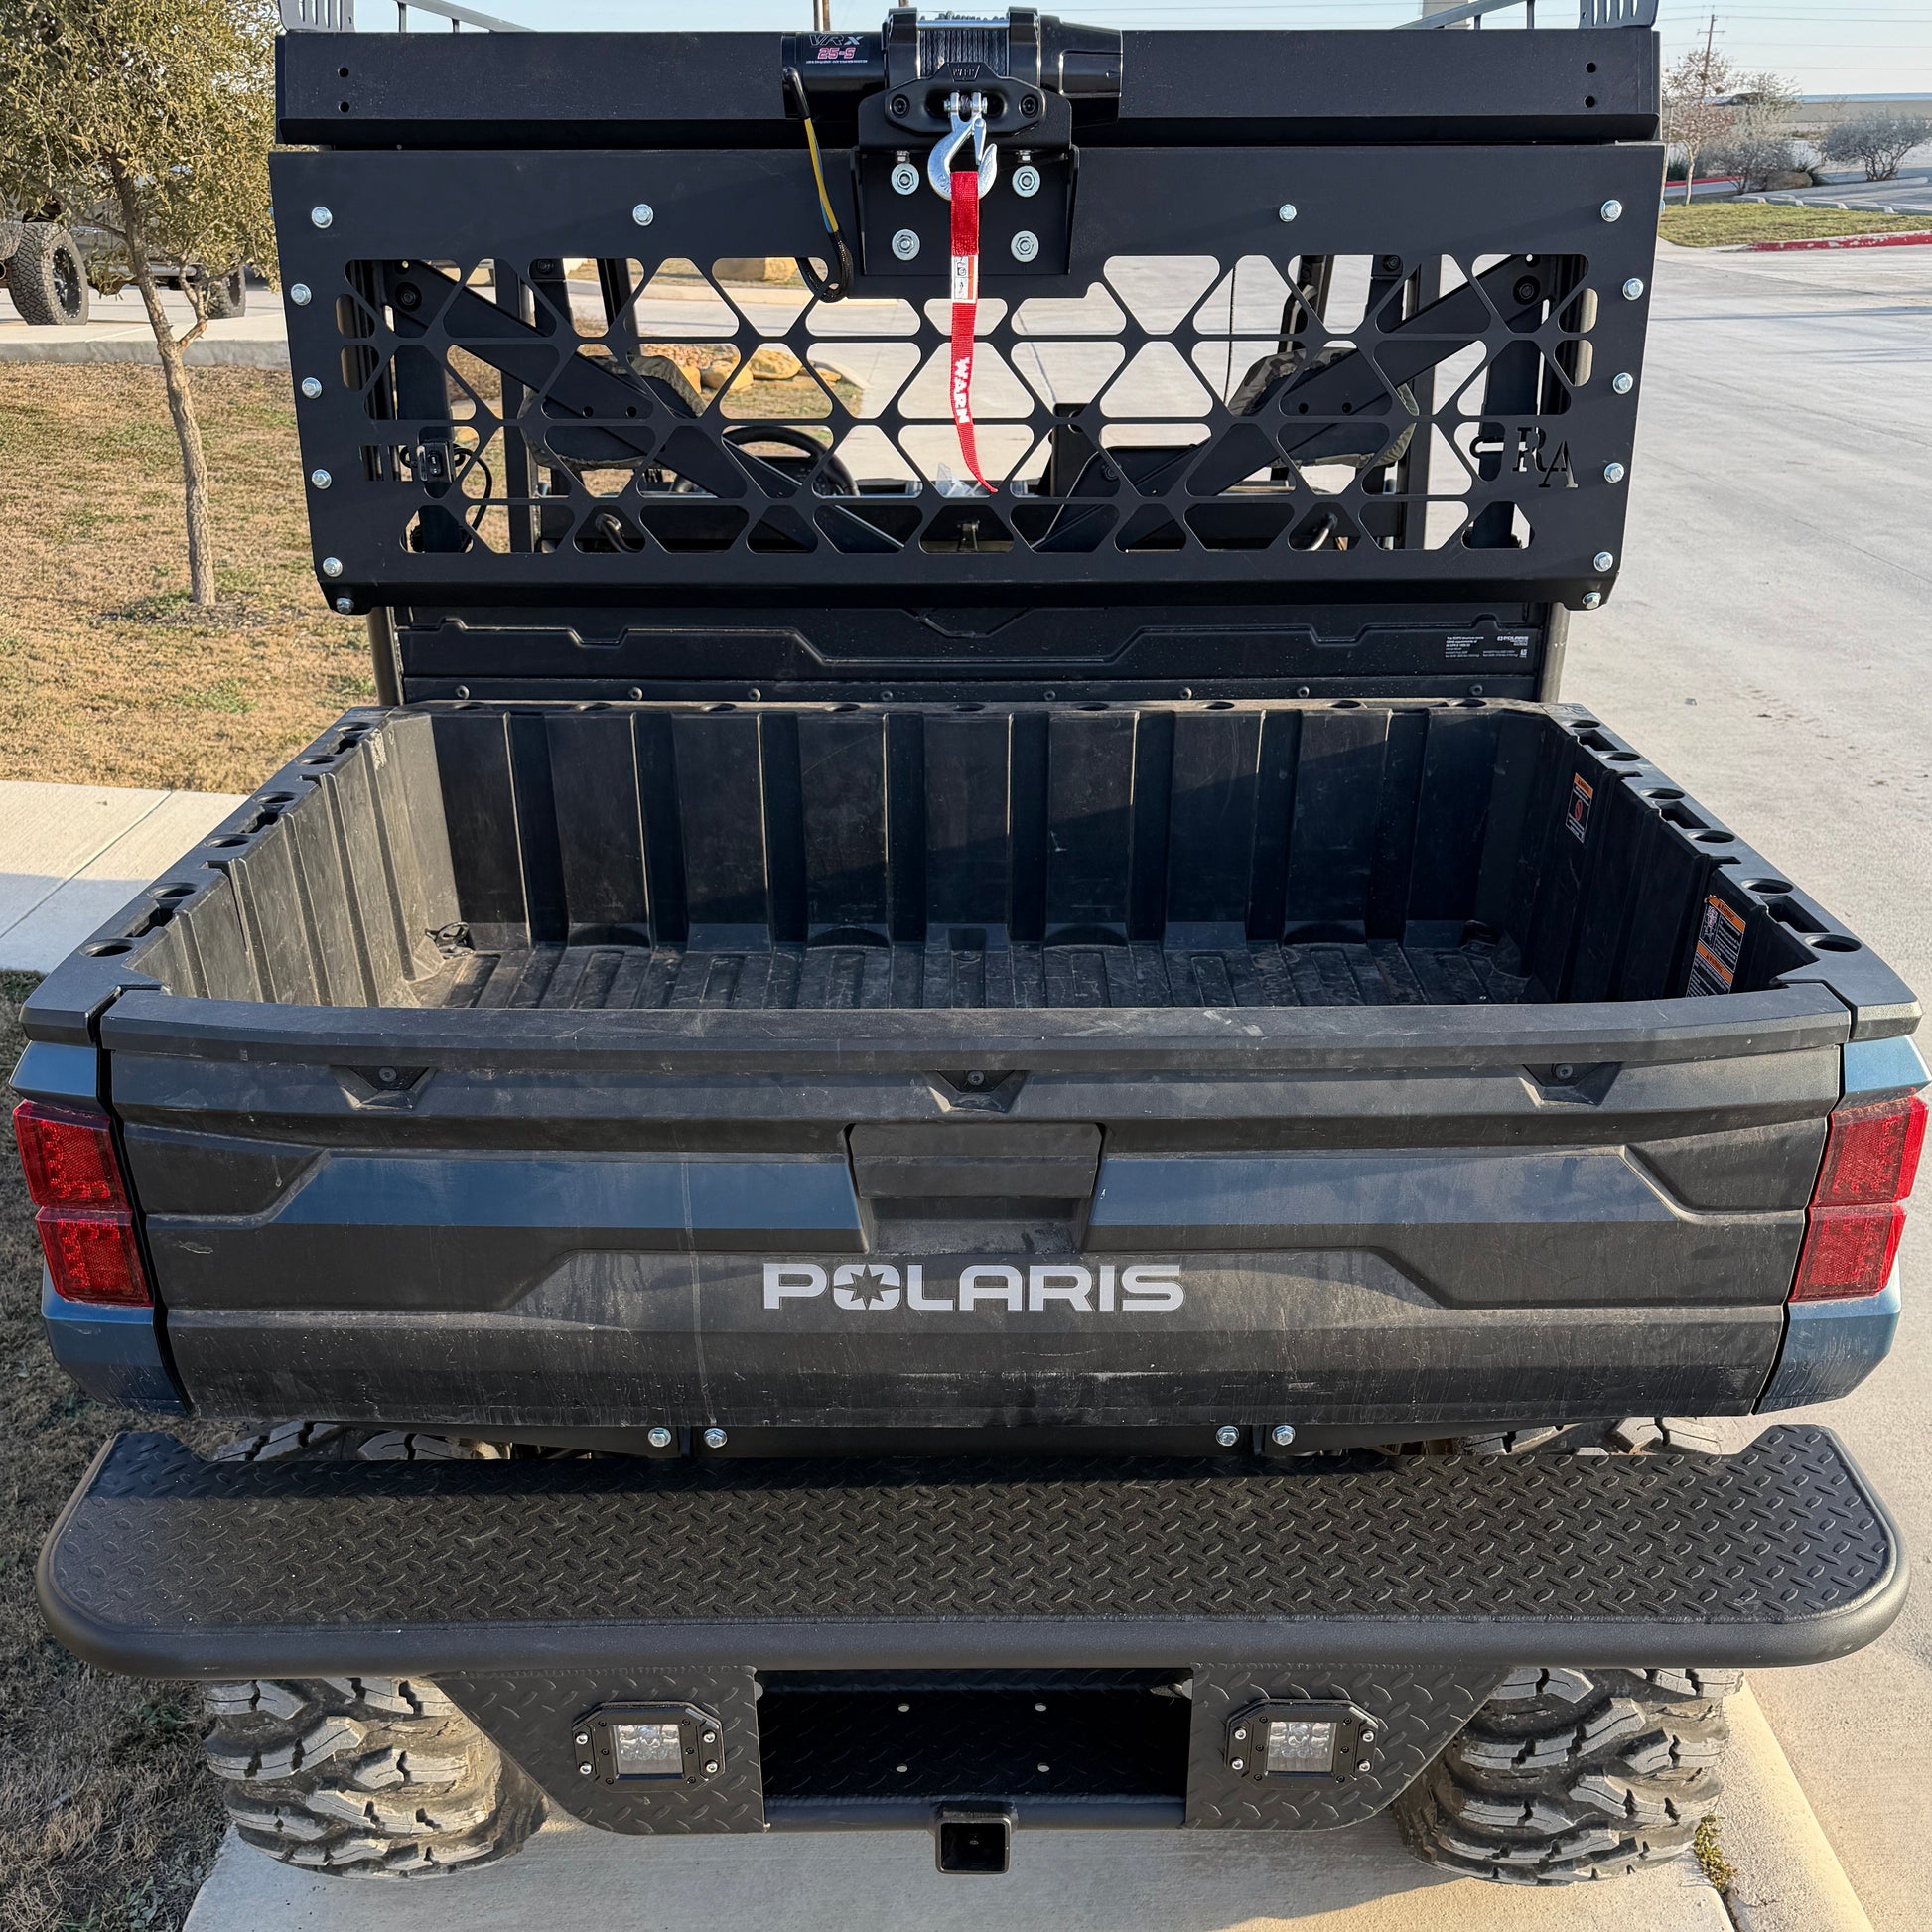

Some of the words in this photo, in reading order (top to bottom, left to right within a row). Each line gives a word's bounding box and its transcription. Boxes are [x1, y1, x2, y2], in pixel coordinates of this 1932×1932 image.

[809, 34, 864, 46] VRX
[954, 356, 970, 424] WARN
[1512, 426, 1579, 488] RA
[763, 1263, 1186, 1311] POLARIS
